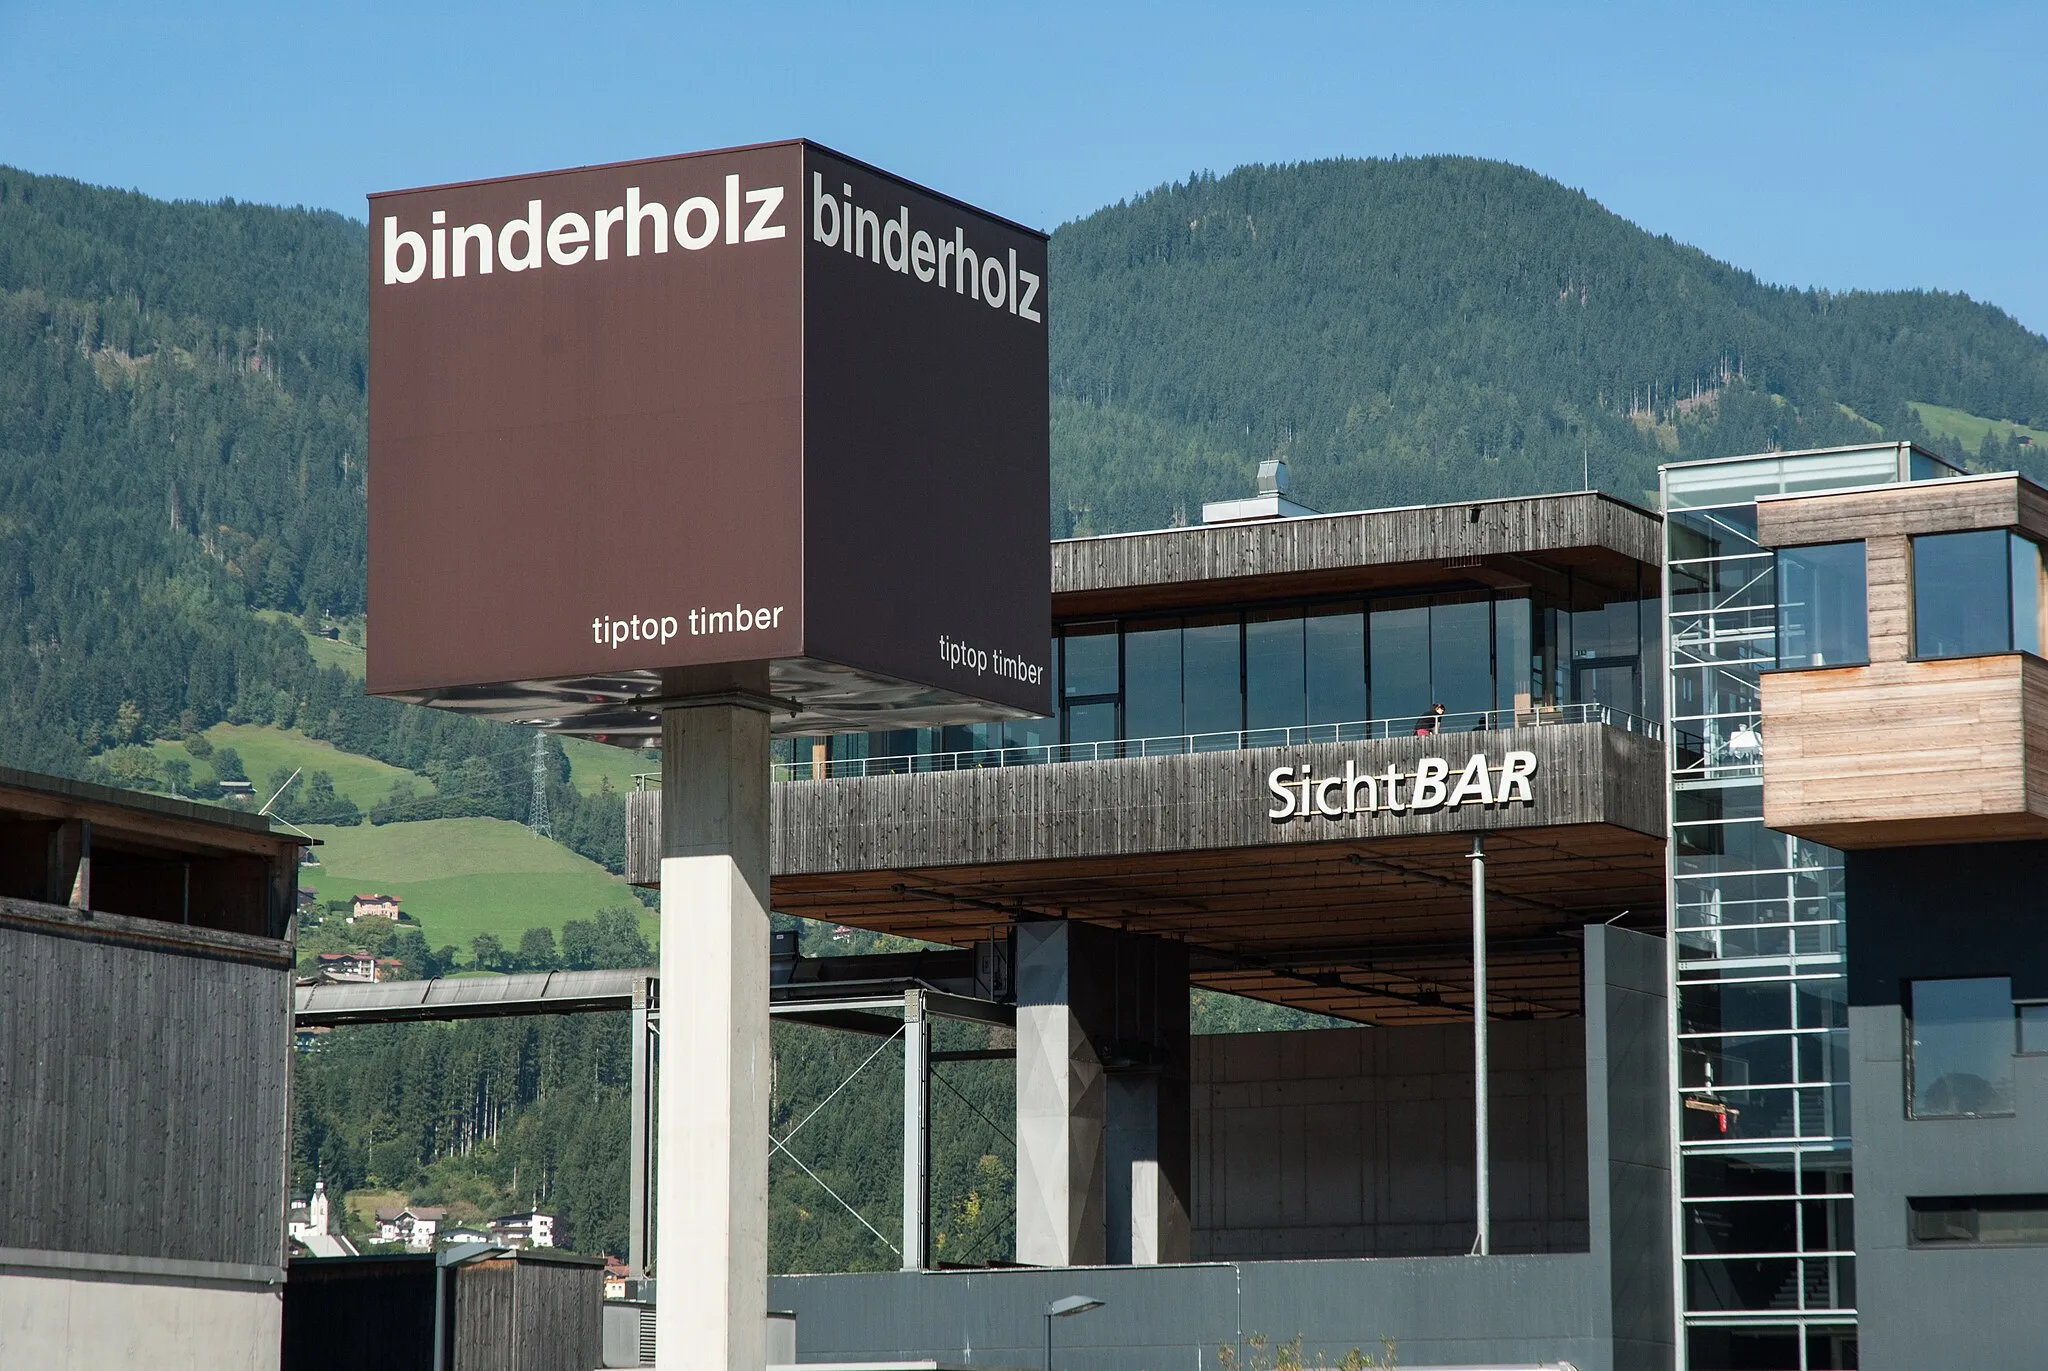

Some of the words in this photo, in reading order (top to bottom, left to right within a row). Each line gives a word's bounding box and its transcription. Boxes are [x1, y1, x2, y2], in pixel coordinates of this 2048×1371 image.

[384, 174, 786, 285] binderholz
[813, 171, 1041, 324] binderholz
[592, 614, 678, 650] tiptop
[688, 603, 784, 636] timber
[938, 634, 988, 677] tiptop
[992, 649, 1044, 686] timber
[1268, 750, 1537, 820] SichtBAR
